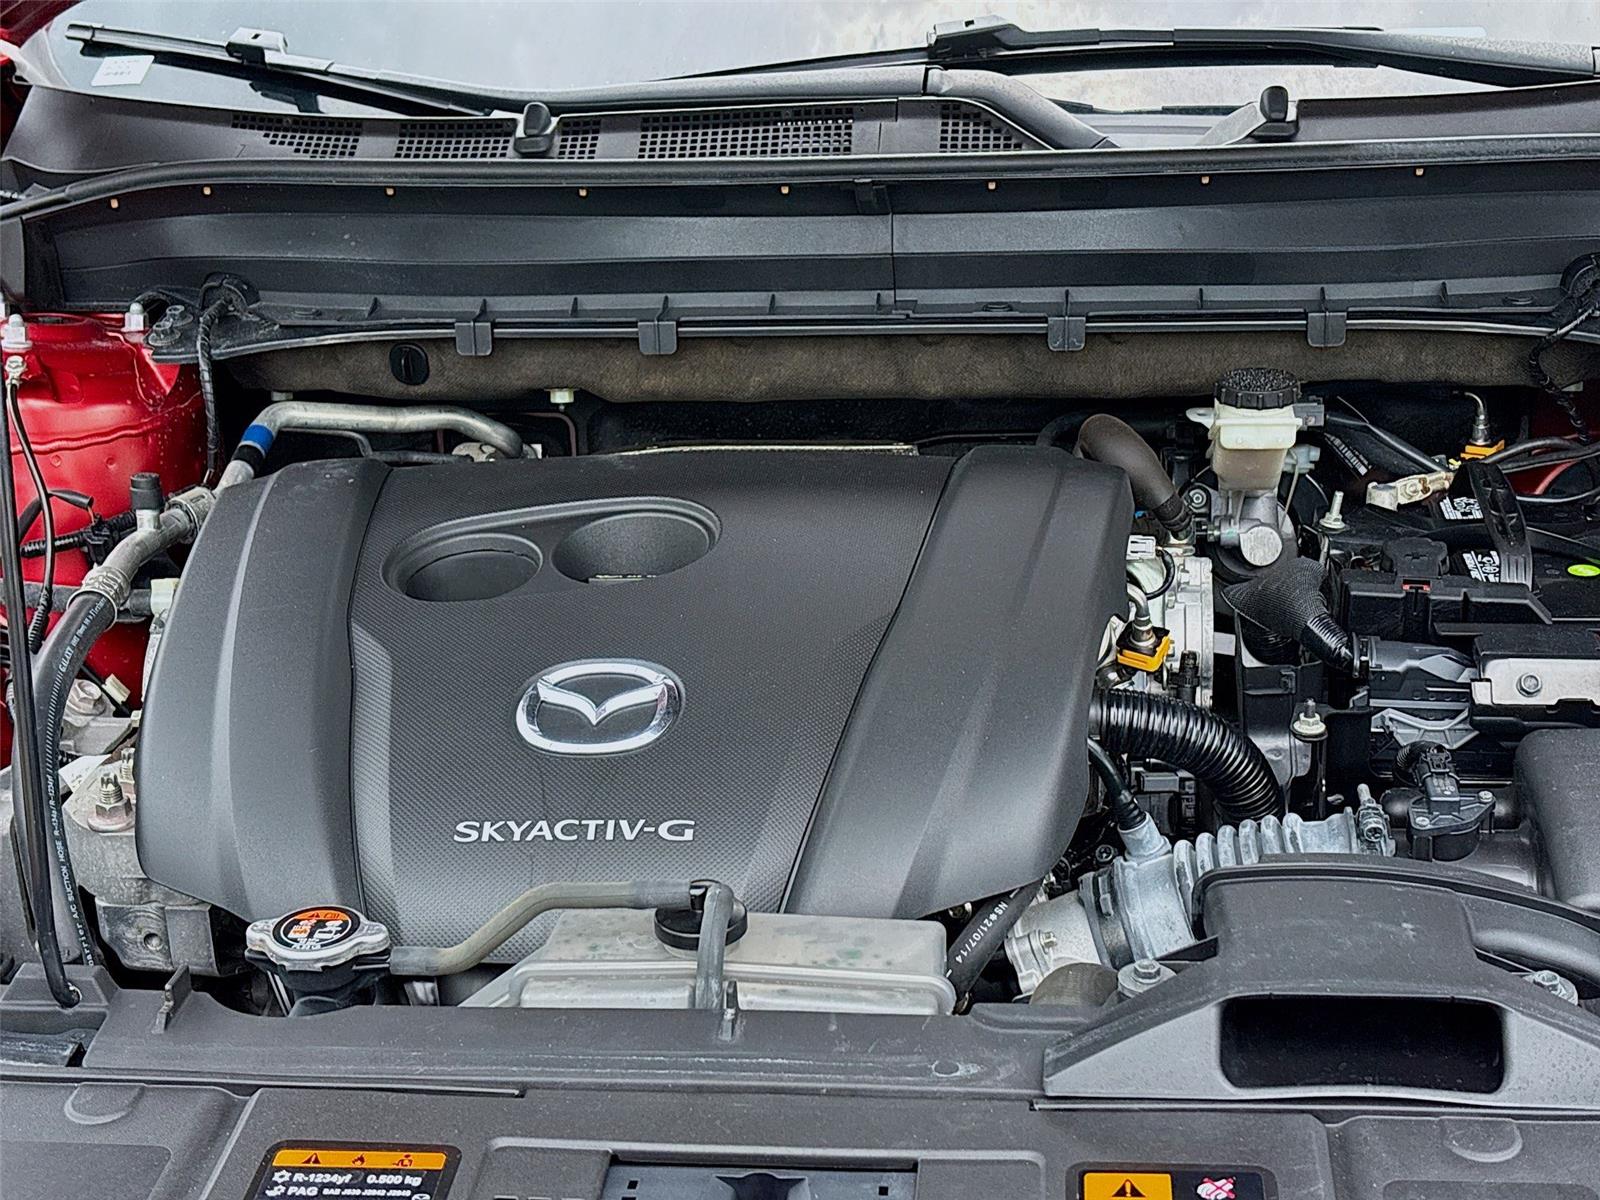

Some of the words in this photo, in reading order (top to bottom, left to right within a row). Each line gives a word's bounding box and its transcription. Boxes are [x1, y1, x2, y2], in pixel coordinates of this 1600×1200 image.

[453, 818, 696, 843] SKYACTIV-G
[55, 840, 66, 862] HOSE
[61, 865, 75, 901] SUCTION
[70, 904, 79, 919] A/C
[292, 1173, 352, 1186] R-1234yf
[366, 1174, 403, 1185] 0.500
[404, 1175, 423, 1187] kg
[287, 1186, 319, 1196] PAG
